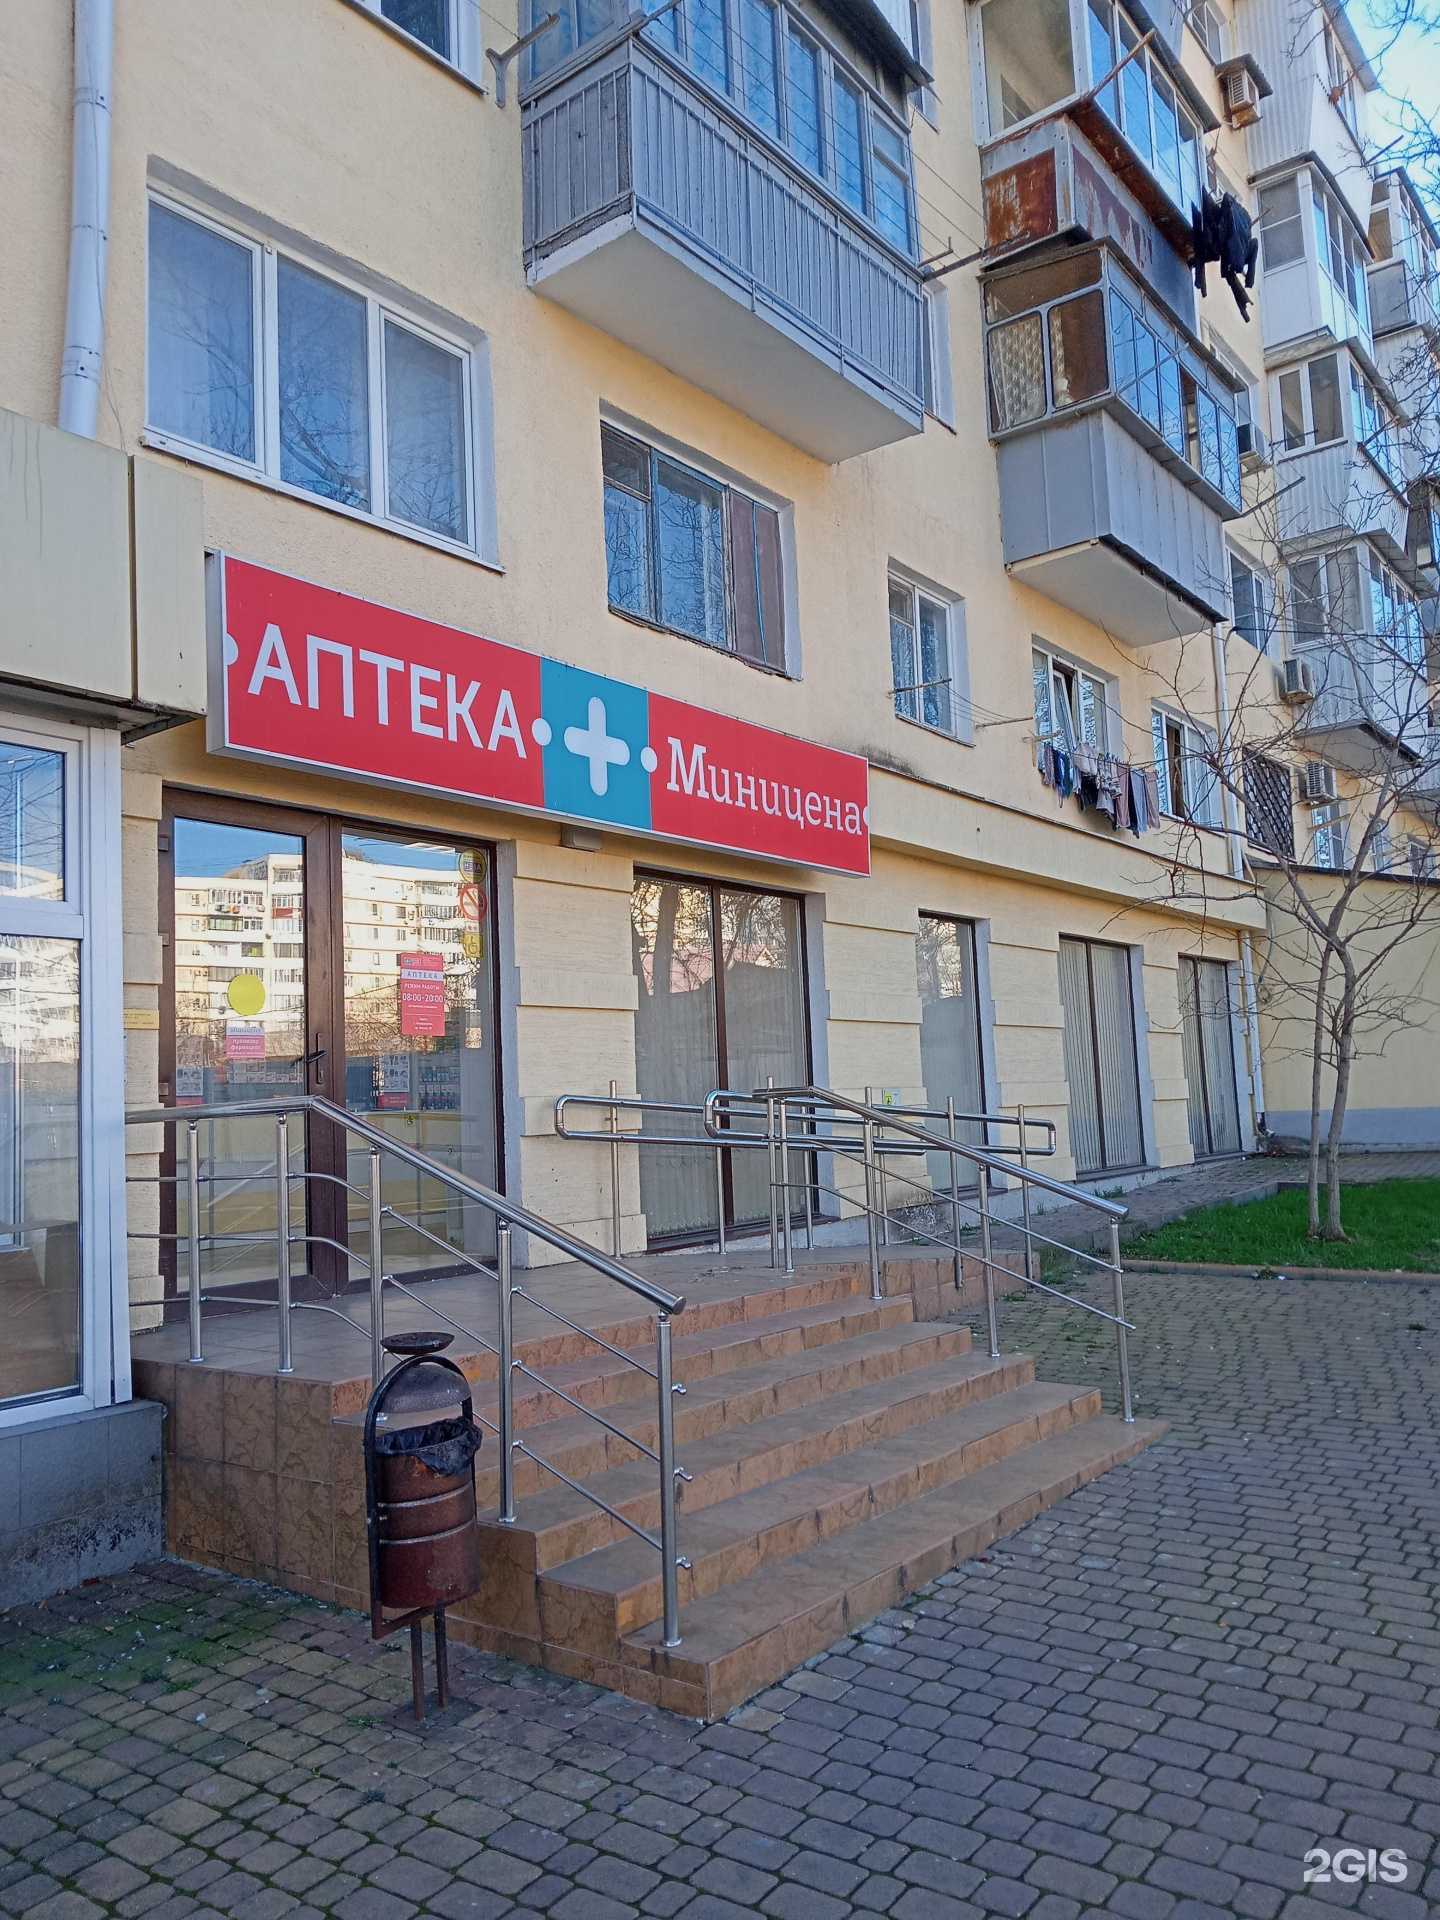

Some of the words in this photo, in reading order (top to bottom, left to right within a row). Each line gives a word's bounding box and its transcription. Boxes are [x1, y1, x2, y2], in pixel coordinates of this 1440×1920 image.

[247, 623, 527, 759] АПТЕКА
[666, 736, 863, 835] Миницена
[407, 971, 438, 980] АПТЕКА
